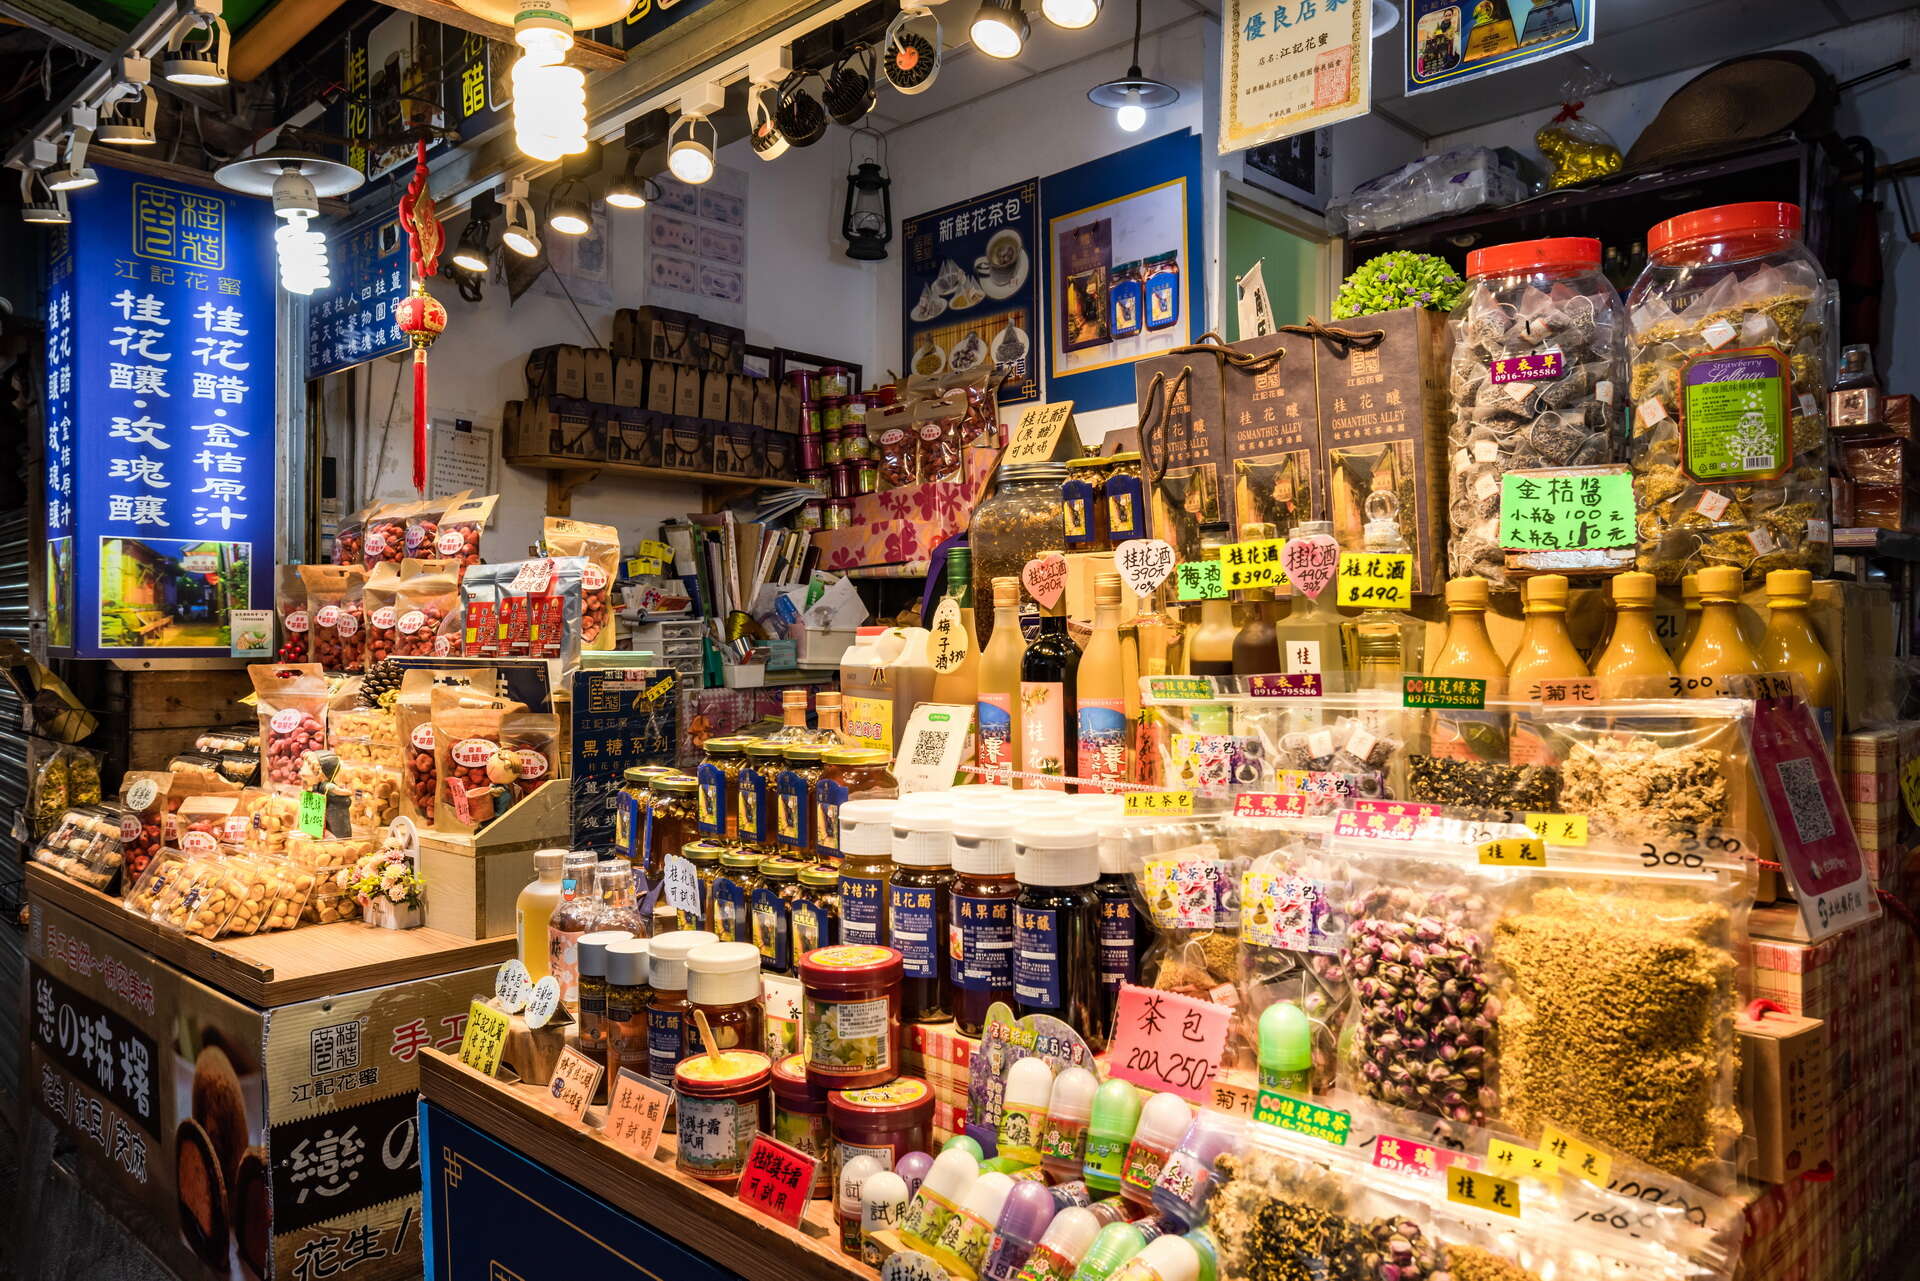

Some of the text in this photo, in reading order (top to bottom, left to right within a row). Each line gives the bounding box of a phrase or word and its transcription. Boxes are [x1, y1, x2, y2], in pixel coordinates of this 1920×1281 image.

[938, 198, 1022, 243] 新鮮花茶包
[114, 258, 241, 296] 江記花蜜
[1494, 354, 1557, 373] 薰衣草
[1494, 367, 1557, 382] 0916-795586
[1022, 405, 1068, 429] 桂花醋
[1331, 408, 1407, 431] OSMANTHUS ALLEY
[1236, 420, 1303, 442] OSMANTHUS ALLEY
[1515, 478, 1602, 507] 金桔醬
[1510, 507, 1625, 524] 小瓶 100 元
[1509, 528, 1562, 550] 大瓶
[1607, 527, 1626, 542] 元
[1123, 546, 1172, 571] 桂花酒
[1226, 545, 1279, 566] 桂花酒
[1286, 545, 1337, 572] 桂花酒
[1131, 564, 1166, 582] 390元
[1180, 563, 1222, 589] 梅酒
[1297, 567, 1330, 583] 490元
[1340, 559, 1406, 581] 桂花酒
[1134, 580, 1157, 593] 10%
[1656, 616, 1678, 638] 12
[935, 617, 950, 670] 梅子酒
[1253, 675, 1316, 689] 薰衣草
[1253, 687, 1318, 697] 0916-795586
[1546, 683, 1596, 702] 菊花
[1407, 694, 1480, 705] 0916-795586
[581, 735, 668, 759] 黑糖系列
[1126, 794, 1191, 809] 桂花茶包
[1238, 795, 1303, 810] 玫瑰花
[1338, 812, 1415, 831] 玫瑰花
[1534, 821, 1579, 840] 桂花
[1487, 842, 1539, 862] 桂花
[841, 880, 879, 900] 金桔汁
[893, 891, 933, 910] 桂花醋
[960, 902, 1008, 920] 蘋果醋
[1137, 994, 1205, 1043] 茶包
[291, 1066, 379, 1104] 江記花蜜
[619, 1087, 661, 1122] 桂花醋
[1258, 1110, 1343, 1145] 0916-795586
[290, 1116, 420, 1205] 戀の
[1551, 1137, 1598, 1177] 桂花
[1456, 1176, 1513, 1208] 桂花
[870, 1200, 909, 1226] 試用
